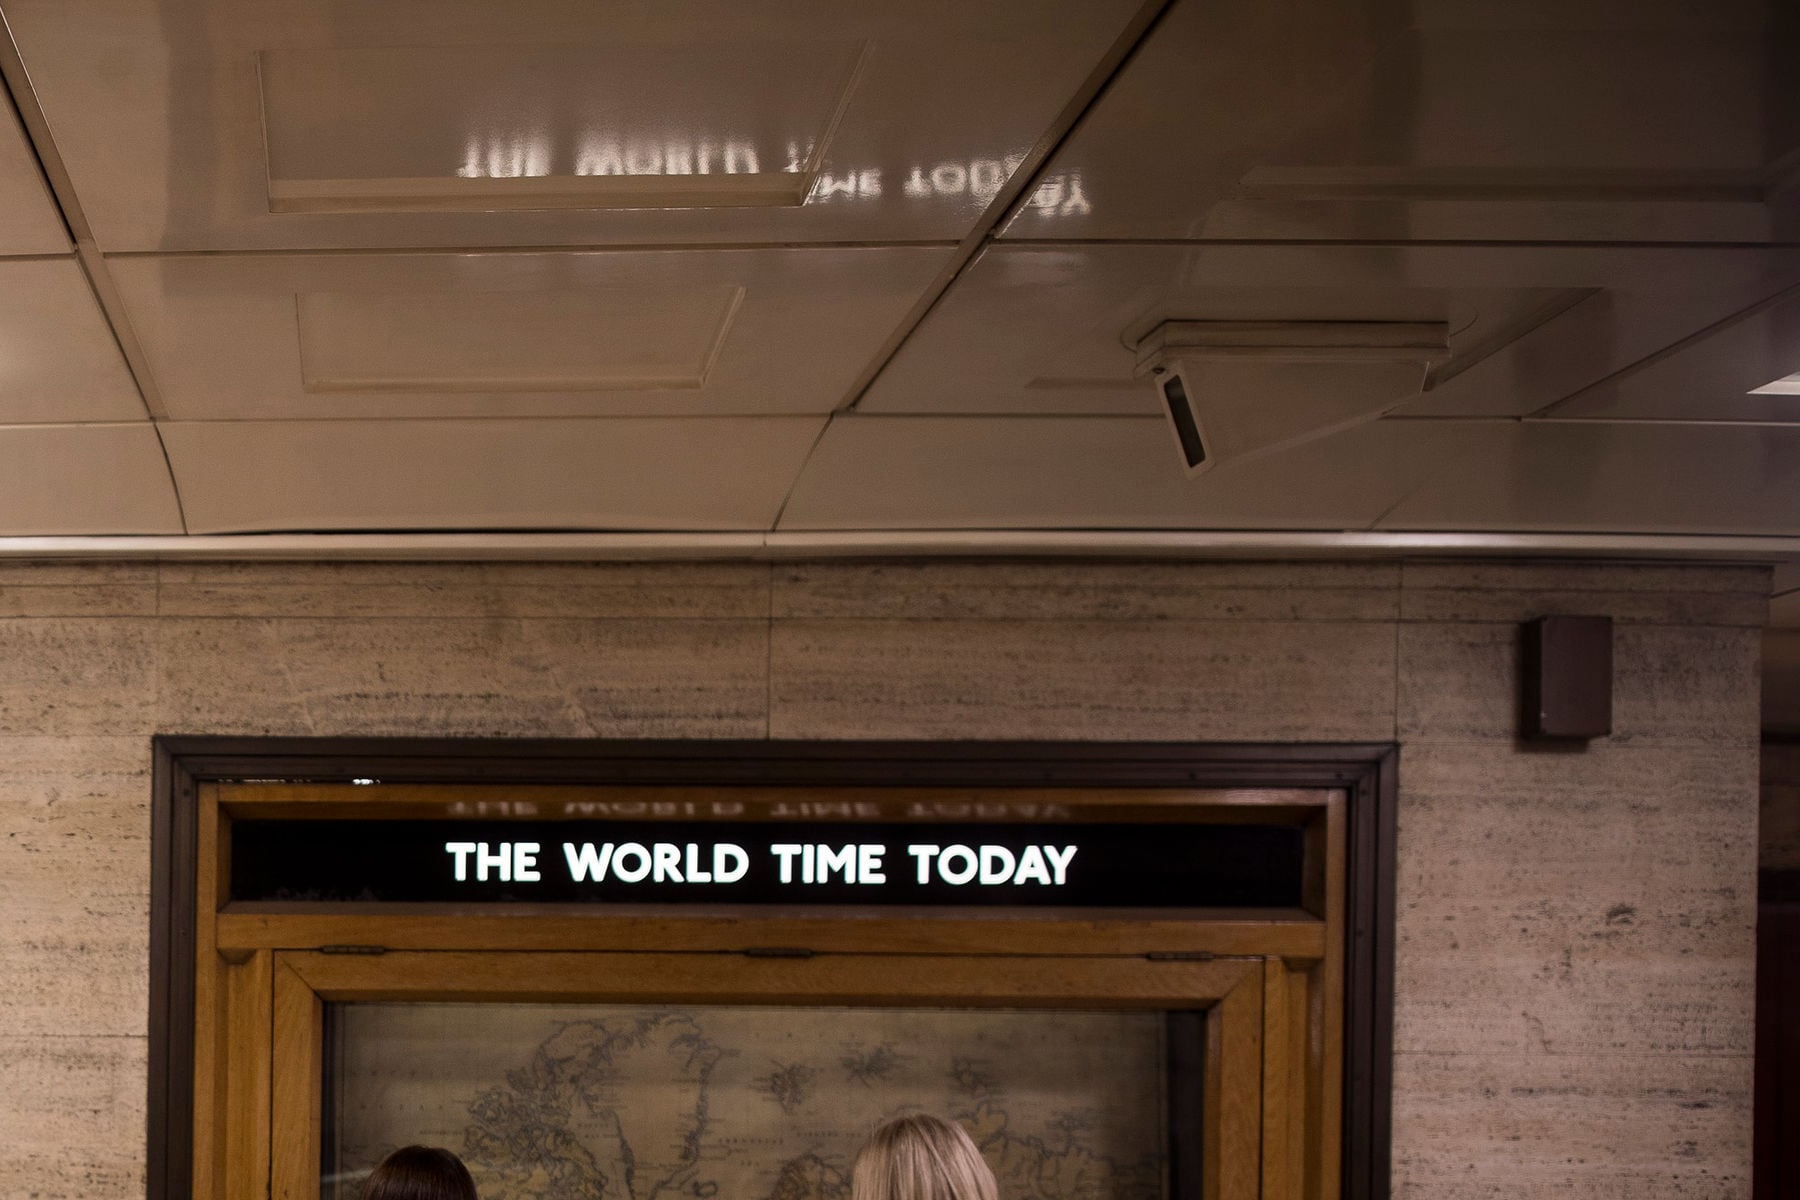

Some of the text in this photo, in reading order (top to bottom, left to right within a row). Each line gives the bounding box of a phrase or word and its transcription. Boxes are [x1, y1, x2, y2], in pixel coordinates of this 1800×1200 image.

[445, 842, 1078, 886] THE WORLD TIME TODAY
